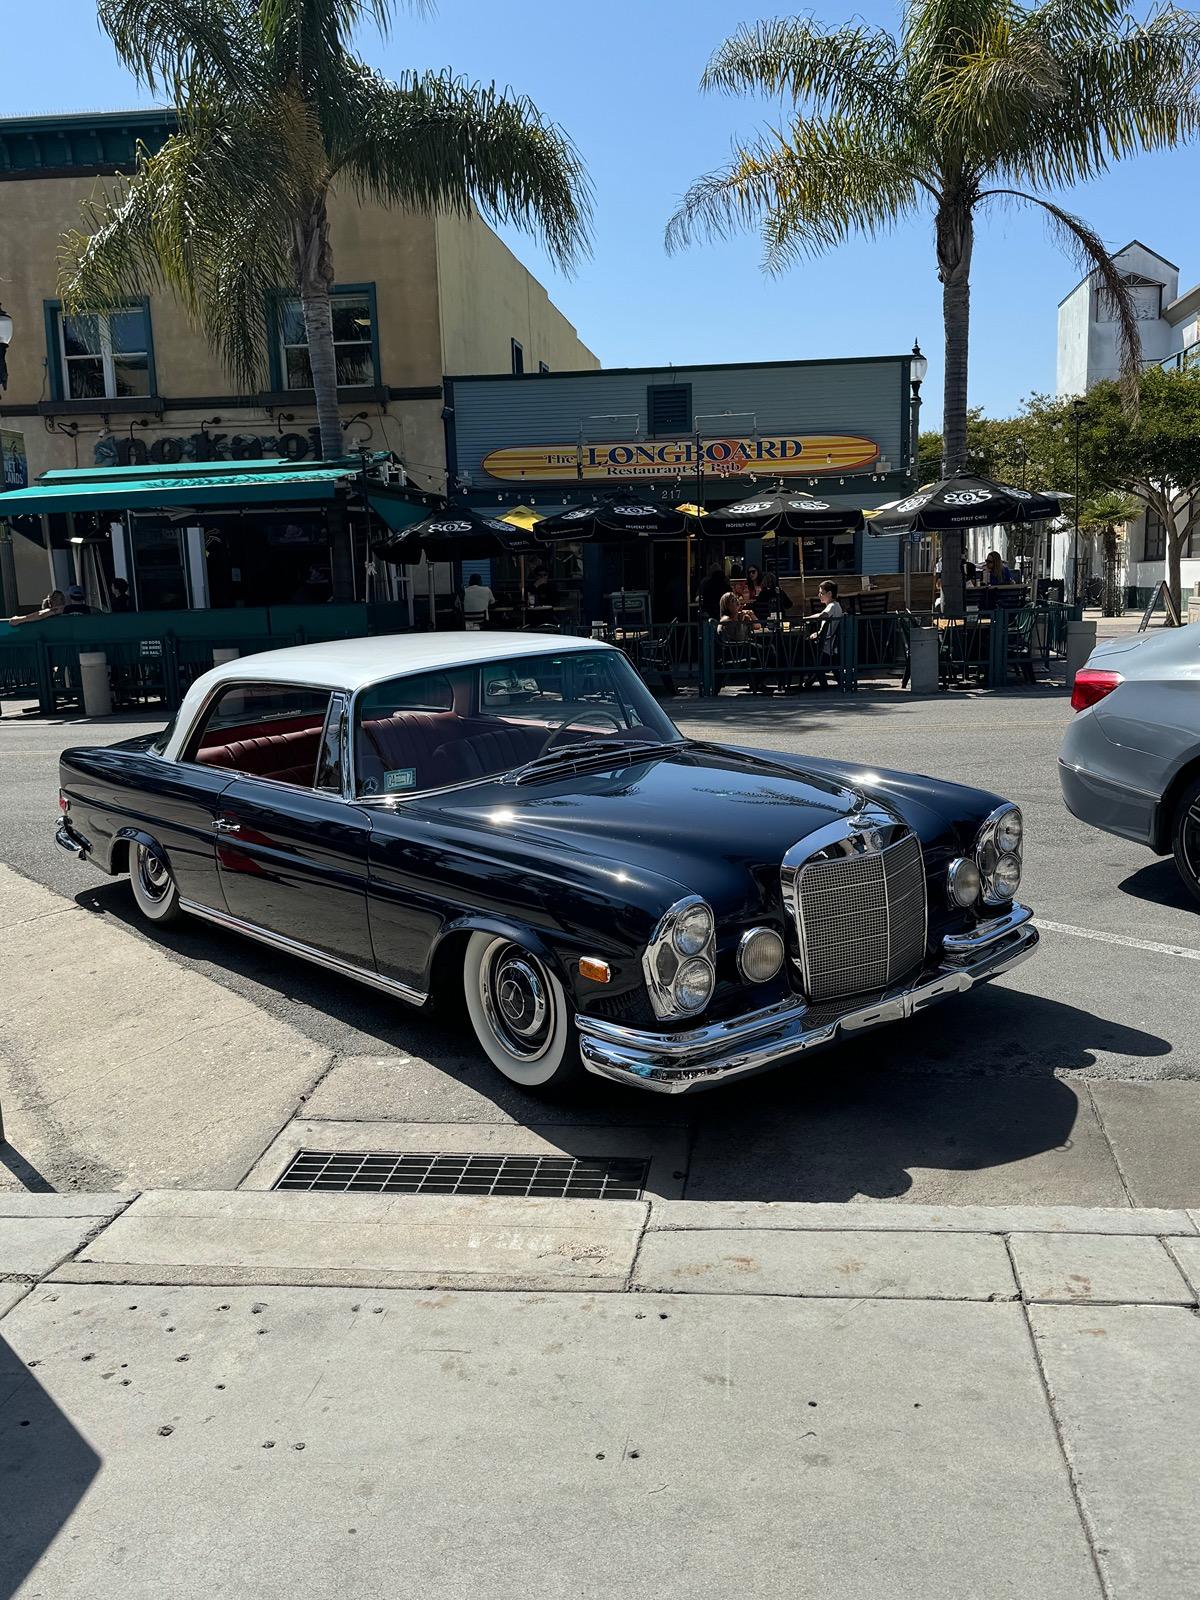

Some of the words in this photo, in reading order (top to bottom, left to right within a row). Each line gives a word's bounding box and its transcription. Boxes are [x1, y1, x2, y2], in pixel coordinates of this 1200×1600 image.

[543, 454, 575, 465] The
[588, 439, 803, 466] LONGBOARD
[607, 464, 688, 476] Restaurant
[711, 461, 741, 473] Pub
[661, 489, 682, 500] 217
[943, 489, 993, 506] 805
[427, 522, 473, 533] 805
